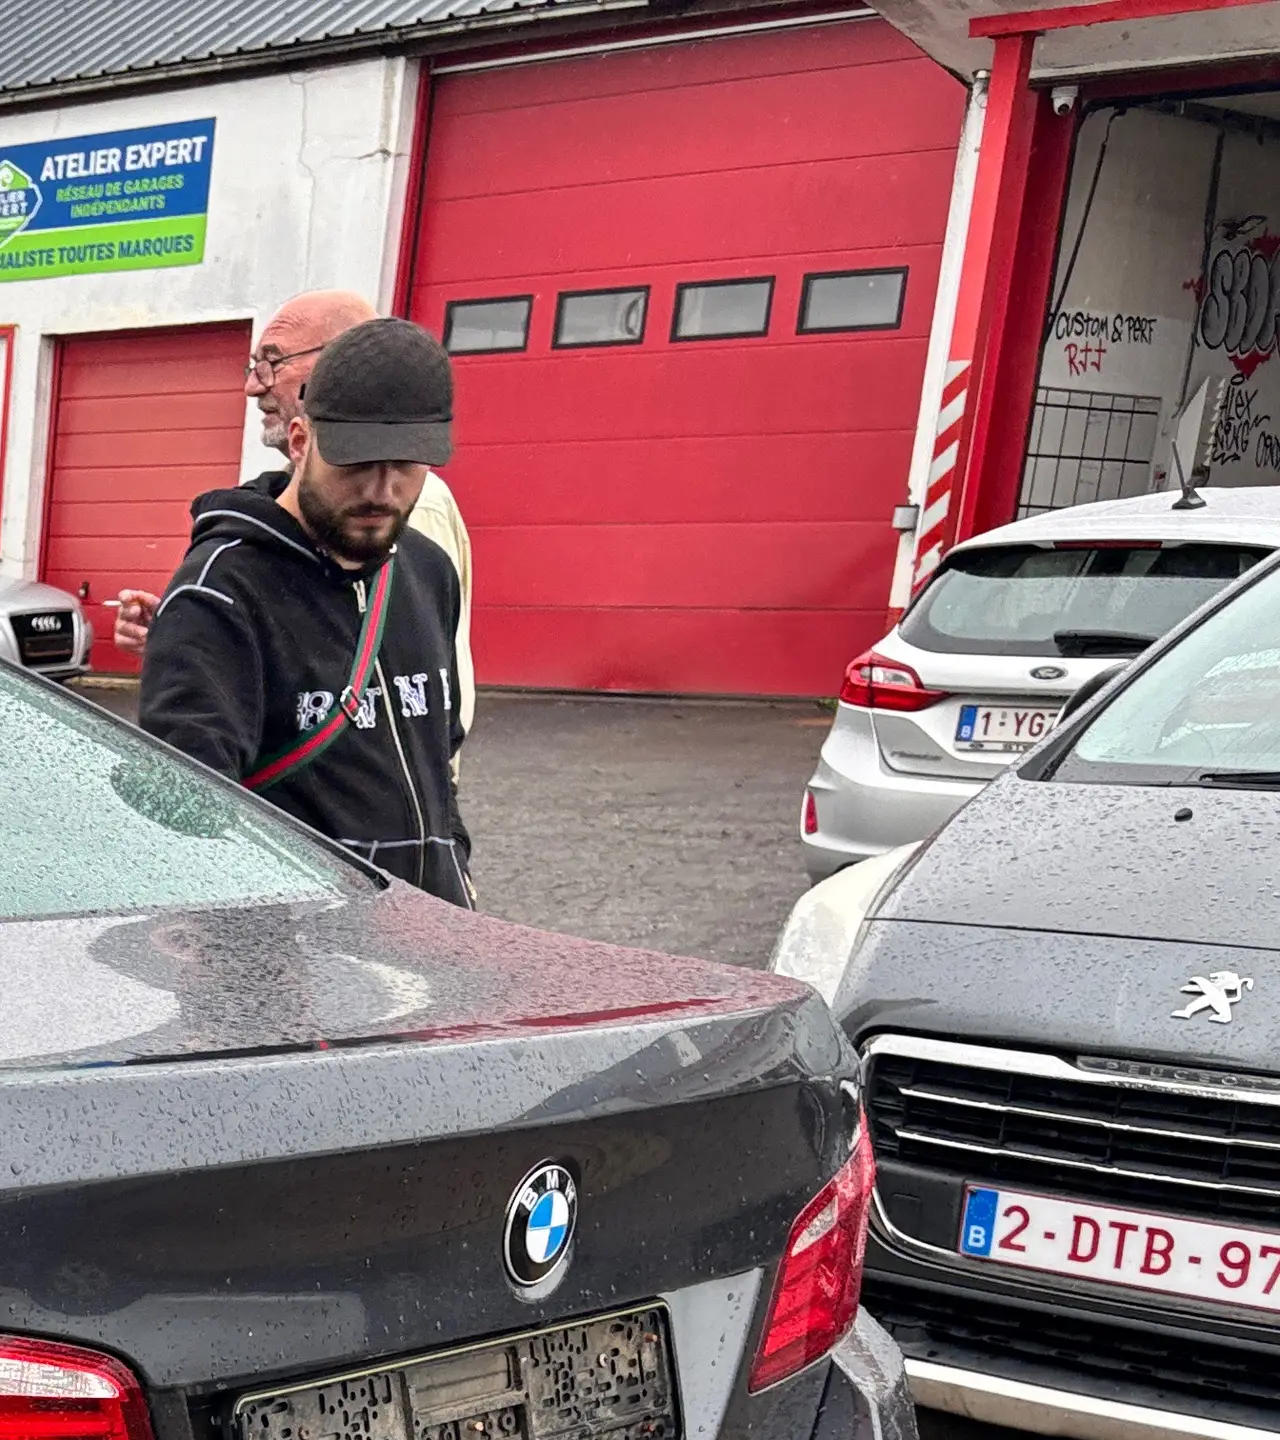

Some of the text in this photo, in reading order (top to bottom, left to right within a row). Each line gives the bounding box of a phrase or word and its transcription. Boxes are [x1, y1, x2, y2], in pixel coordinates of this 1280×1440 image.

[40, 136, 208, 183] ATELIER EXPERT
[56, 174, 185, 203] RÉSEAU DE GARAGES
[70, 194, 166, 218] INDÉPENDANTS
[58, 241, 116, 265] TOUTES
[118, 234, 195, 260] MARQUES
[520, 1168, 576, 1212] BMW
[967, 1224, 986, 1248] B
